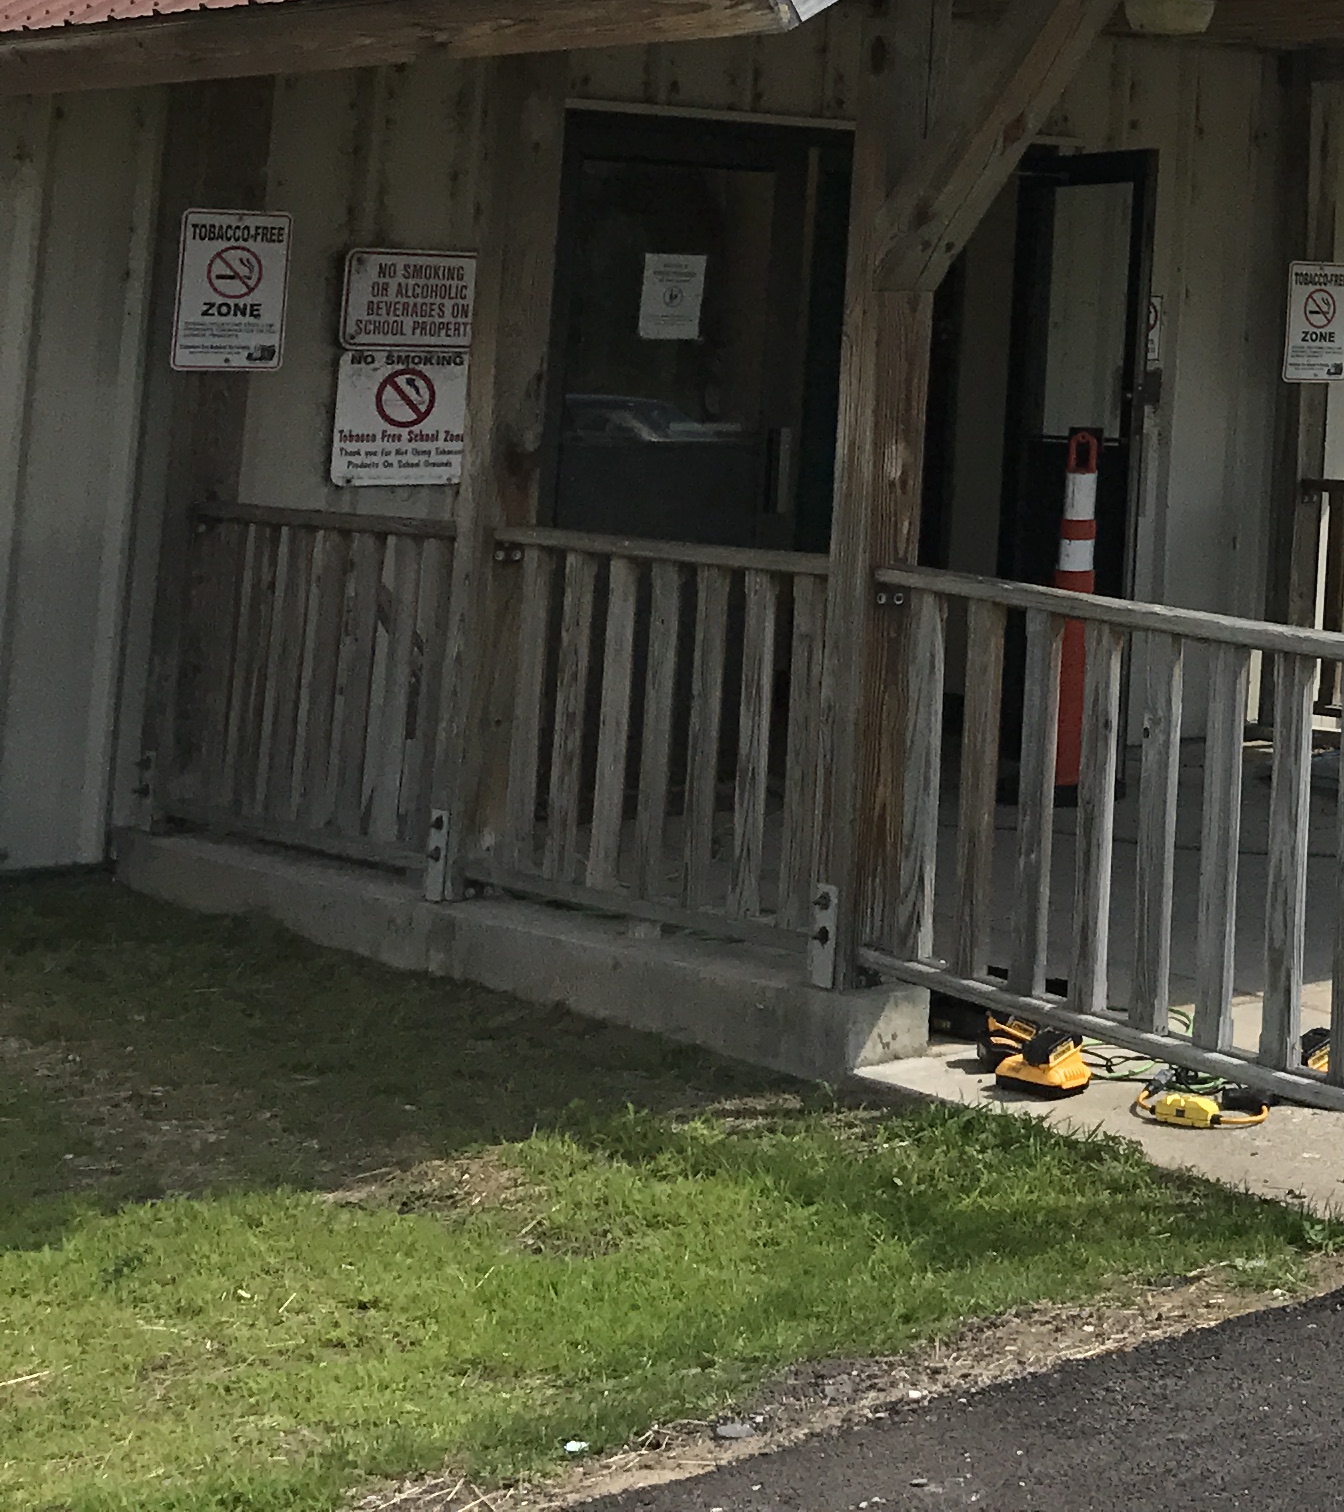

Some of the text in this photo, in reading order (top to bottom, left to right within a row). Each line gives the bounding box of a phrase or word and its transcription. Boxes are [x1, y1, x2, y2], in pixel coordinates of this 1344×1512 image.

[191, 222, 285, 244] TOBACCO-FREE
[378, 262, 464, 281] NO SMOKING
[371, 281, 468, 300] OR ALCOHOLIC
[201, 302, 262, 318] ZONE
[366, 300, 469, 319] BEVERAGES ON
[354, 319, 471, 338] SCHOOL PROPERT
[1301, 331, 1335, 343] ZONE
[350, 353, 465, 366] NO SMOKING
[338, 429, 377, 443] Tobacco
[380, 429, 403, 443] Free
[407, 429, 439, 443] School
[383, 459, 394, 468] On
